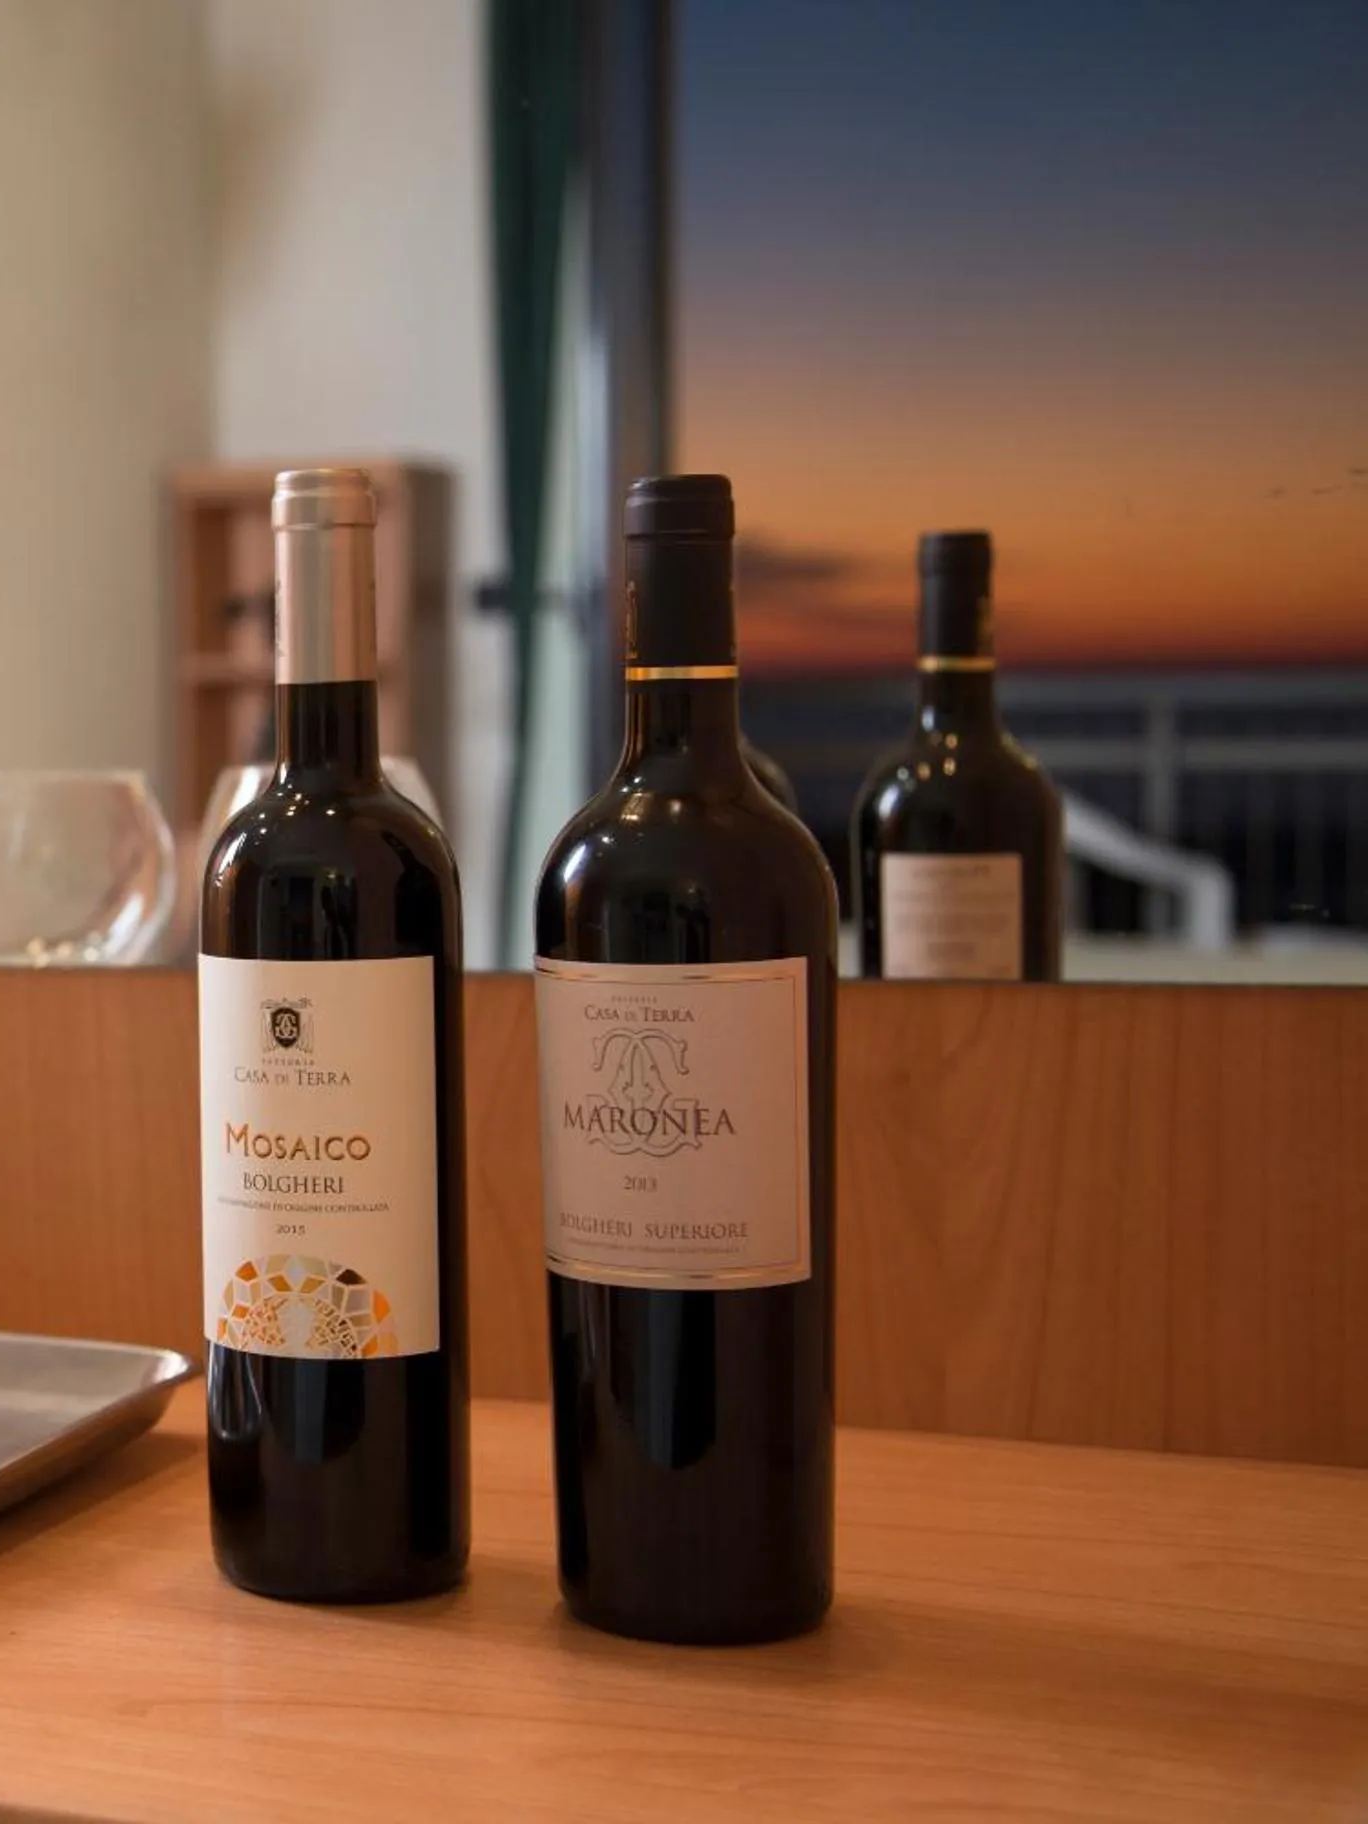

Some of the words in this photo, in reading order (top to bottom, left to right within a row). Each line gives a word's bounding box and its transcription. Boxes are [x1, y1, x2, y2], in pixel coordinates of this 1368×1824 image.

[584, 1004, 620, 1020] CASA
[638, 1005, 695, 1022] TERRA
[234, 1066, 270, 1084] CASA
[293, 1069, 351, 1086] TERRA
[563, 1102, 736, 1137] MARONEA
[225, 1123, 371, 1162] MOSAICO
[243, 1172, 344, 1195] BOLGHERI
[277, 1225, 306, 1236] 2015
[560, 1211, 633, 1238] BOLGHERI
[644, 1220, 749, 1240] SUPERIORE
